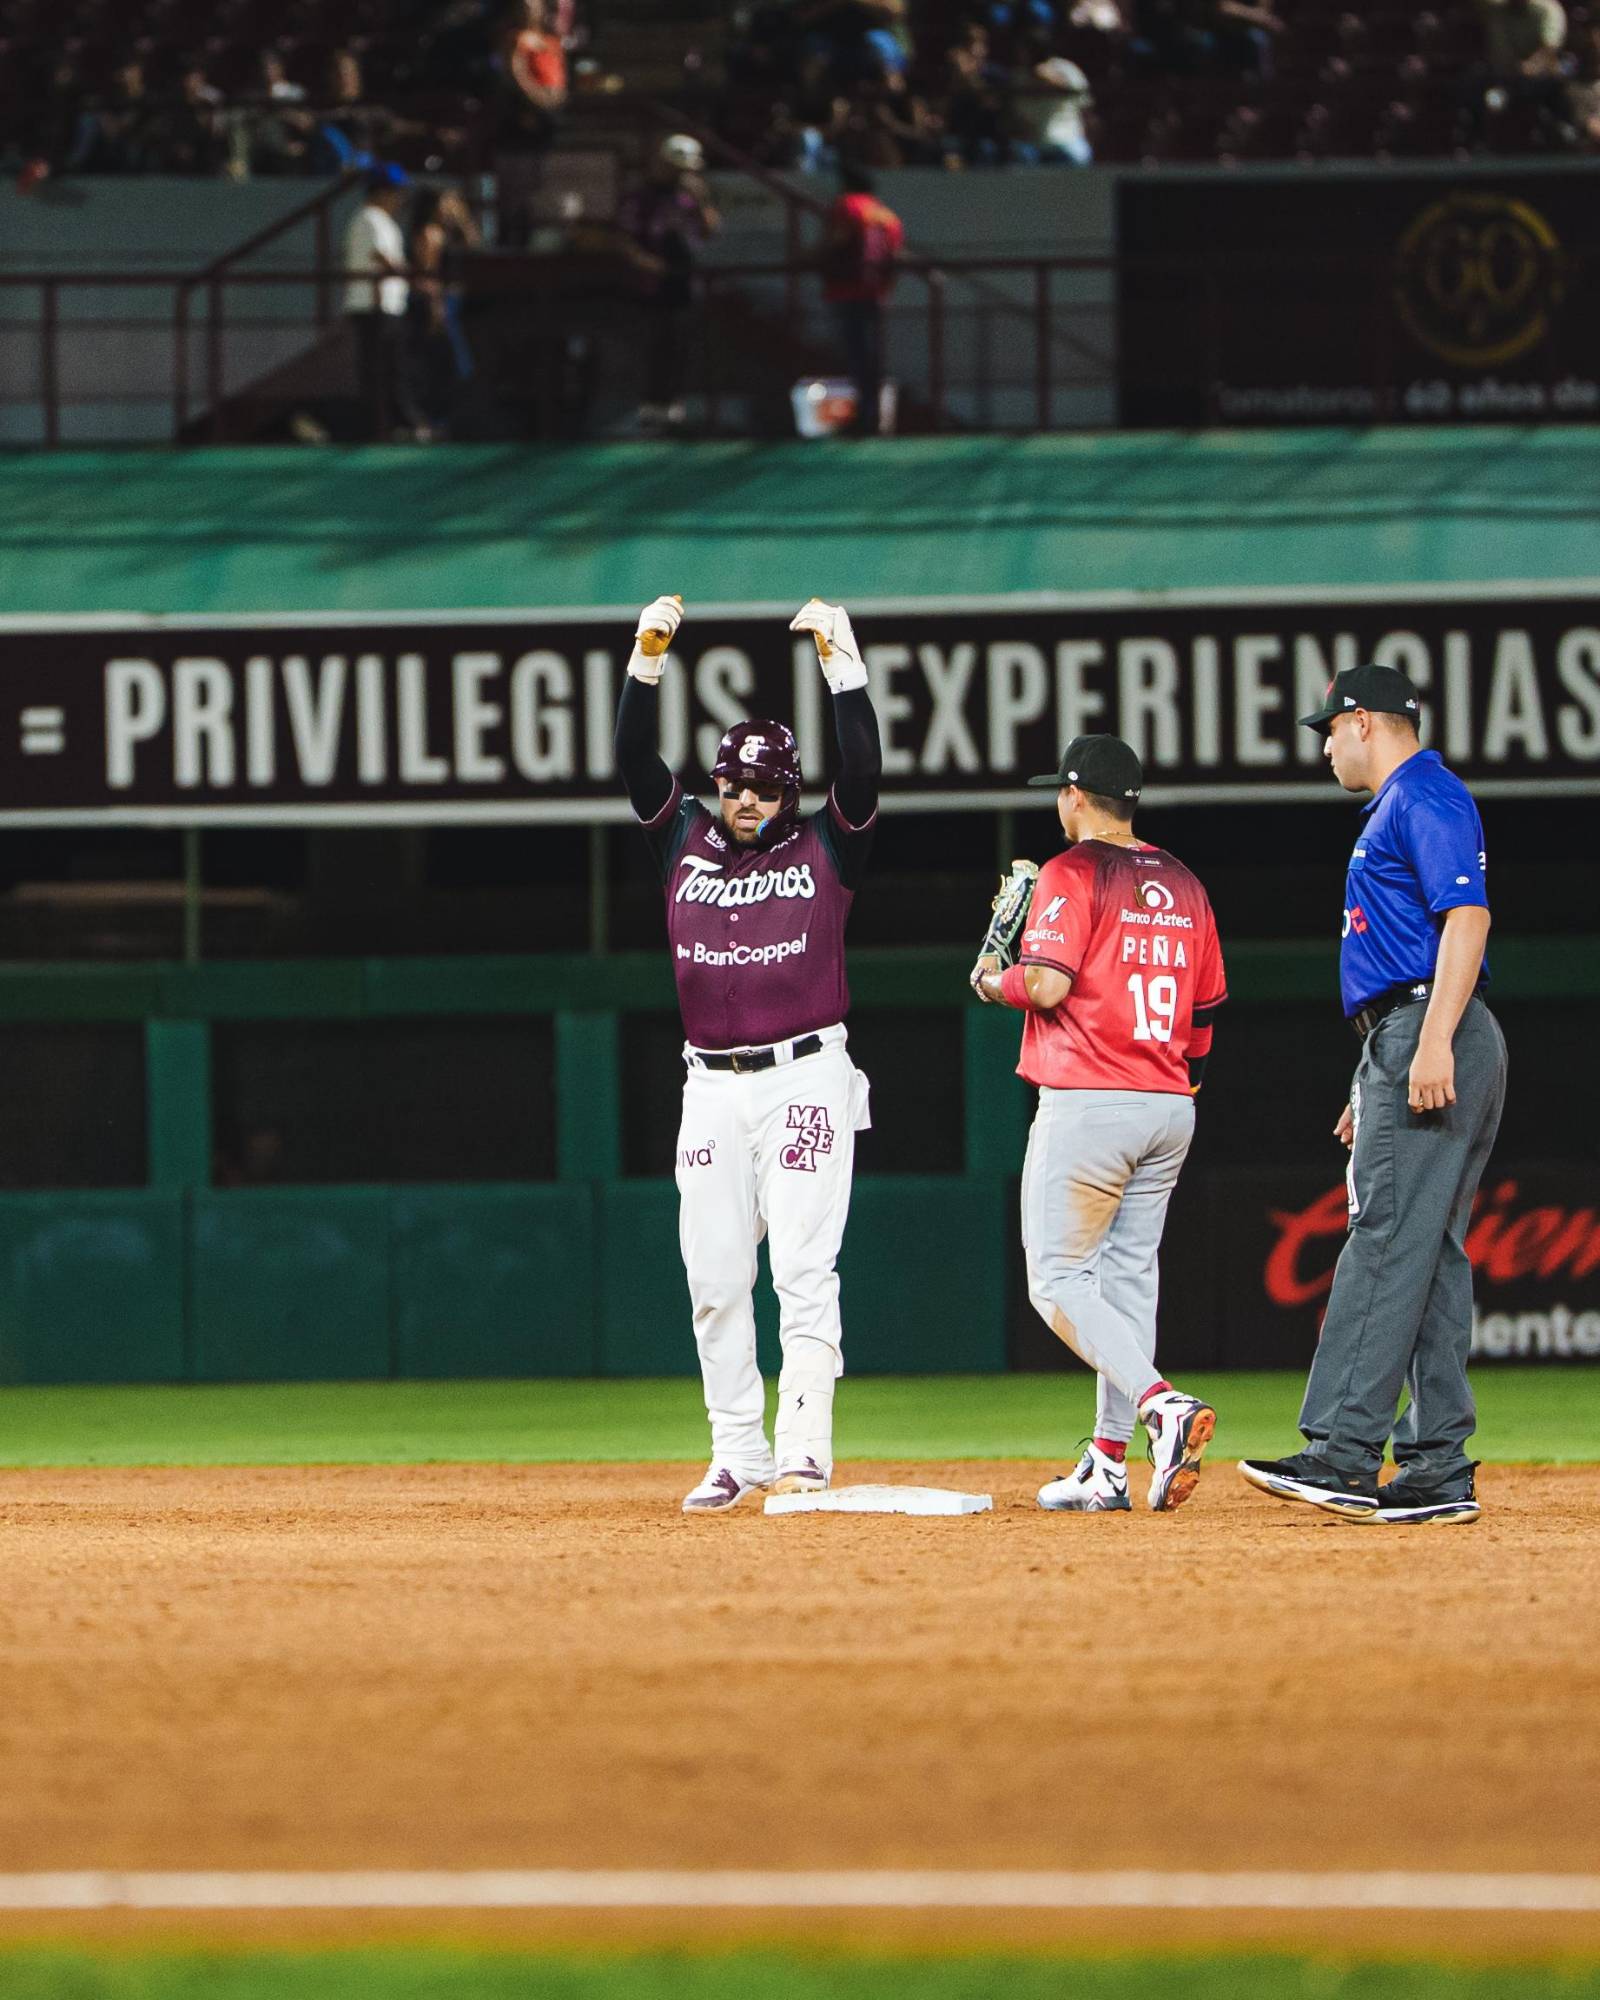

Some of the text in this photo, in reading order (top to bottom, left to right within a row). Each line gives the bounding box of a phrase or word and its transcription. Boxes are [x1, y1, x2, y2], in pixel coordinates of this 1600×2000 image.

[675, 854, 816, 908] Tomateros
[1120, 908, 1151, 925] Banco
[694, 933, 808, 966] BanCoppel
[1122, 934, 1187, 968] PEÑA
[1127, 972, 1177, 1043] 19
